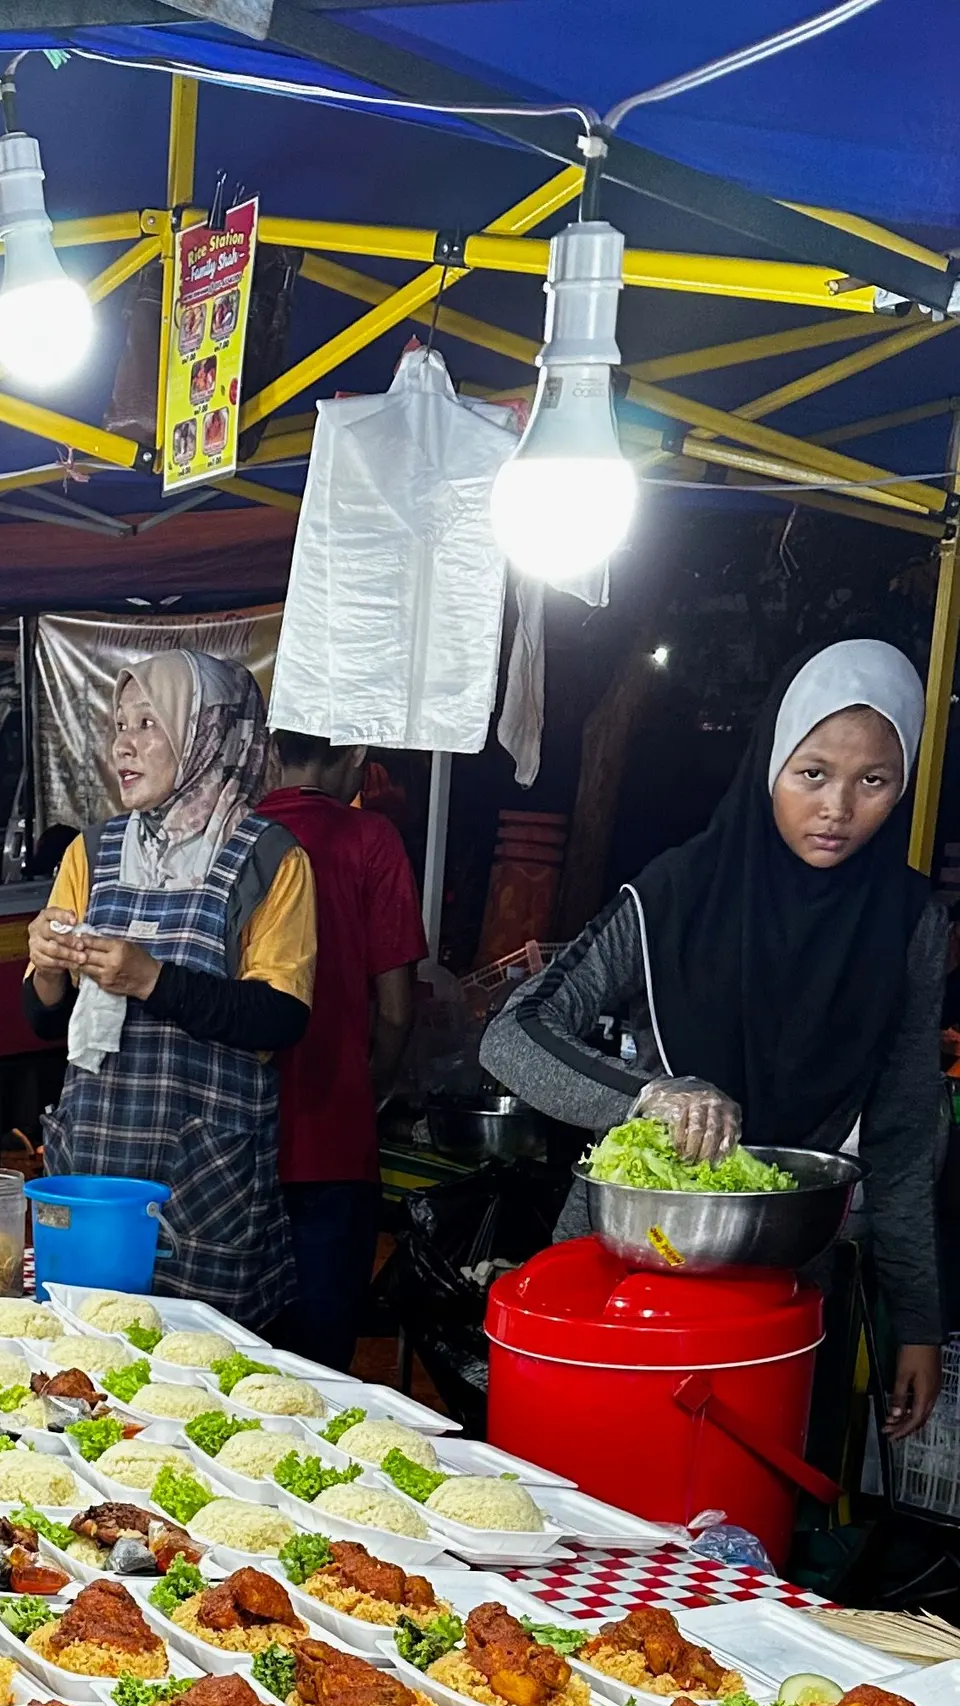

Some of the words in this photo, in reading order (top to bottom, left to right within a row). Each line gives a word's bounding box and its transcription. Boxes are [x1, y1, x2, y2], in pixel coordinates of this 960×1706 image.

[188, 245, 207, 267] Rice
[210, 228, 244, 252] Station
[191, 258, 216, 281] Family
